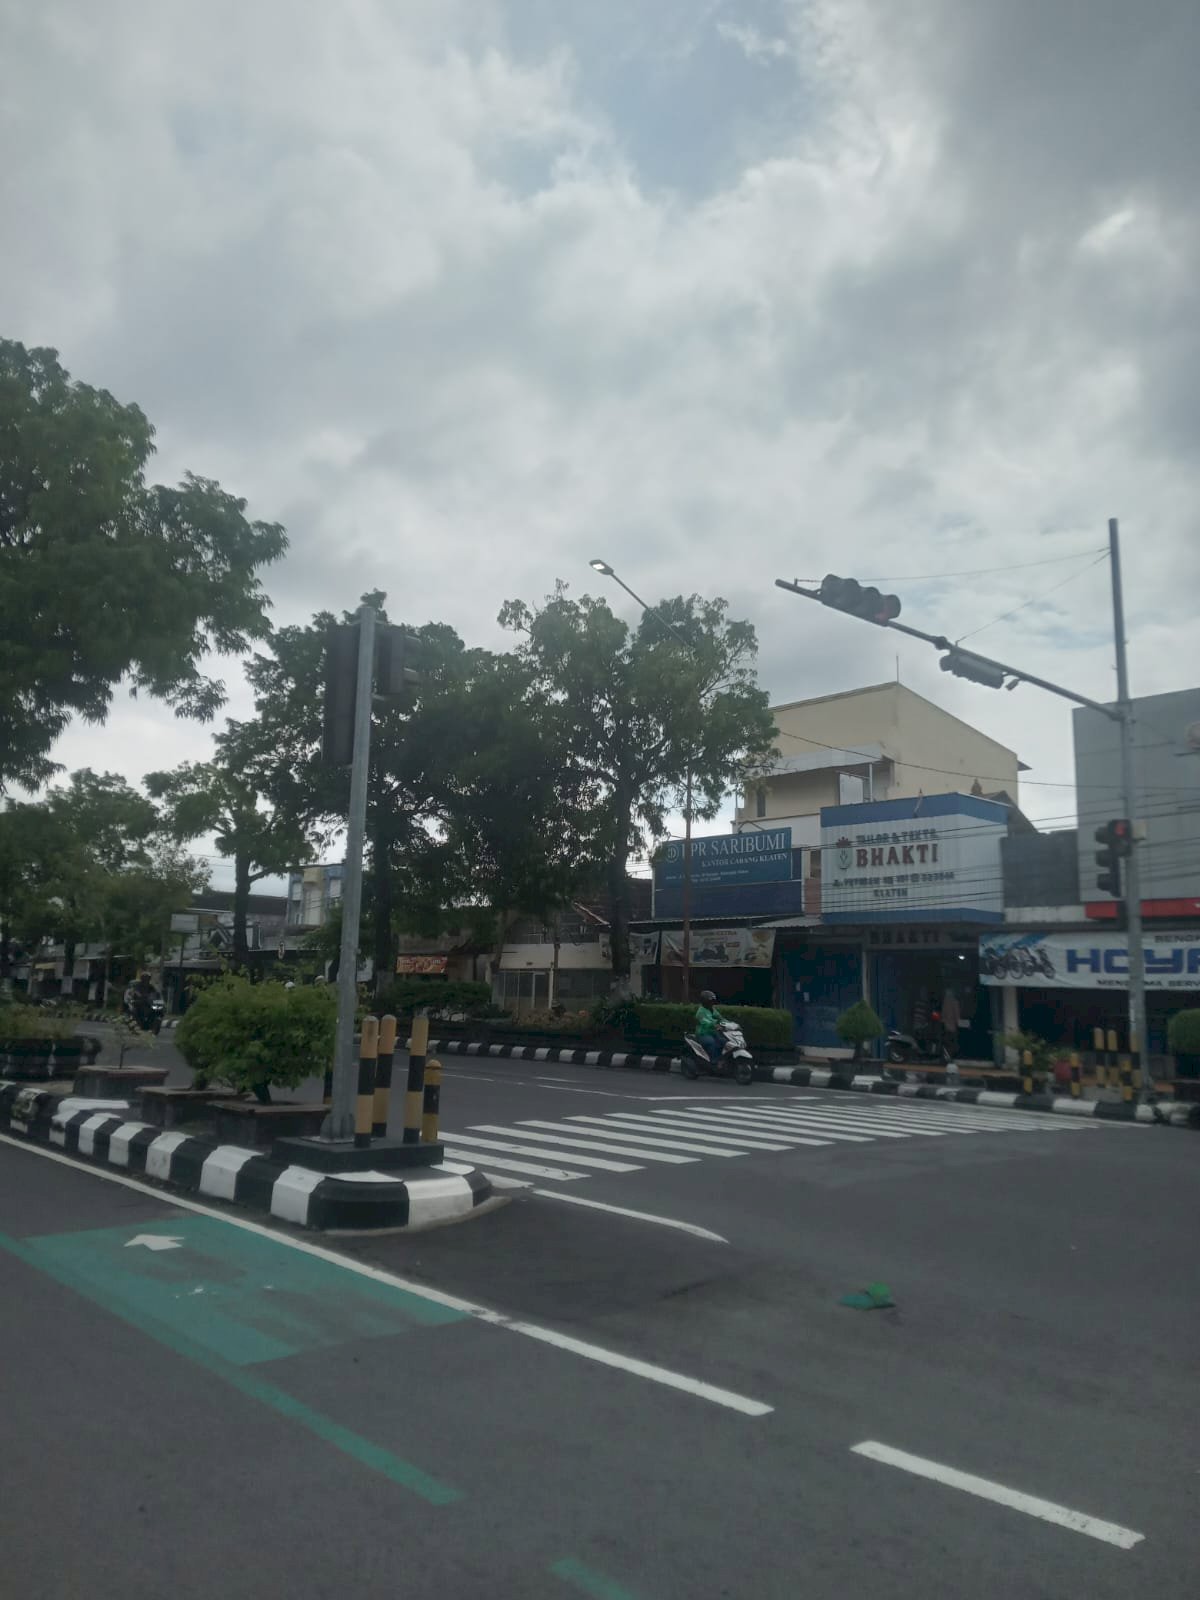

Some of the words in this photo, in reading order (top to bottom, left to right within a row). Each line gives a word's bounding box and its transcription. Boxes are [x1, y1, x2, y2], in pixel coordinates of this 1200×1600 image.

[682, 841, 707, 860] PR
[711, 832, 786, 856] SARIBUMI
[855, 843, 938, 867] BHAKTI
[702, 858, 729, 868] KANTOR
[730, 856, 758, 865] CABANG
[759, 852, 788, 863] KLATEN
